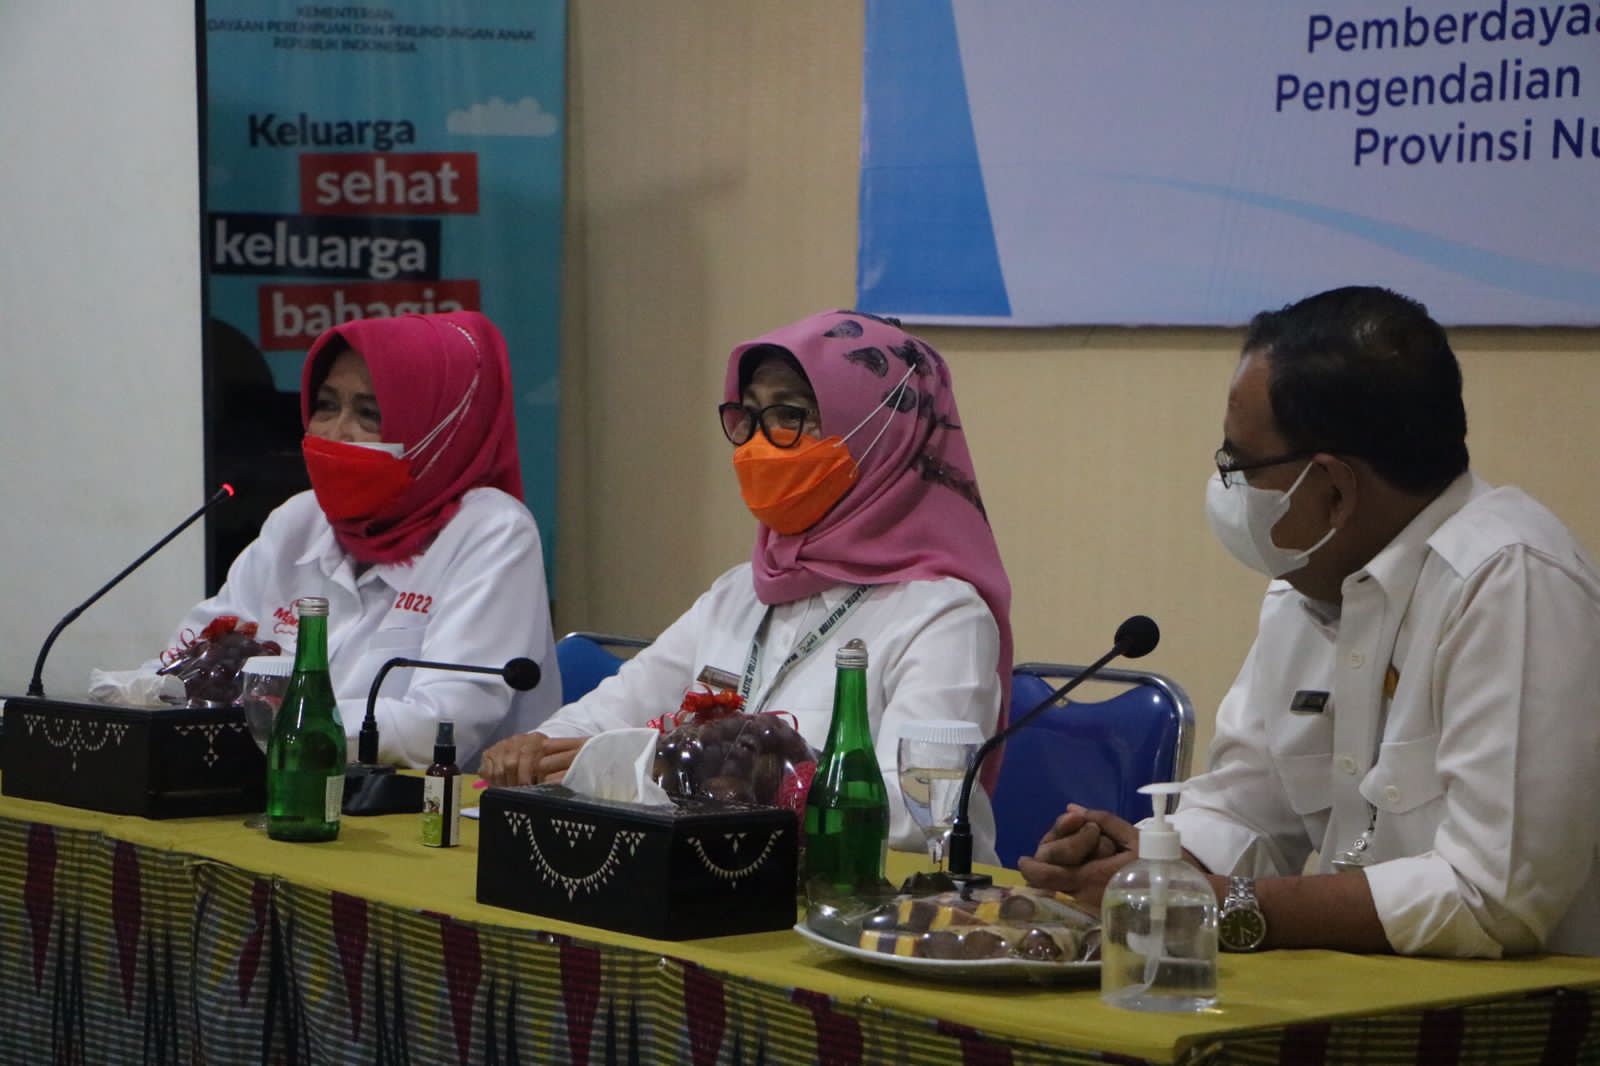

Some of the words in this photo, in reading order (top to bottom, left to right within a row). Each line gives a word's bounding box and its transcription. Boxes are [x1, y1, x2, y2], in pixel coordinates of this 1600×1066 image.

[1307, 0, 1600, 54] Pemberdaya
[1275, 58, 1581, 117] Pengendalian
[248, 114, 415, 151] Keluarga
[1354, 118, 1533, 167] Provinsi
[316, 158, 460, 206] sehat
[214, 219, 426, 280] keluarga
[395, 592, 433, 614] 2022
